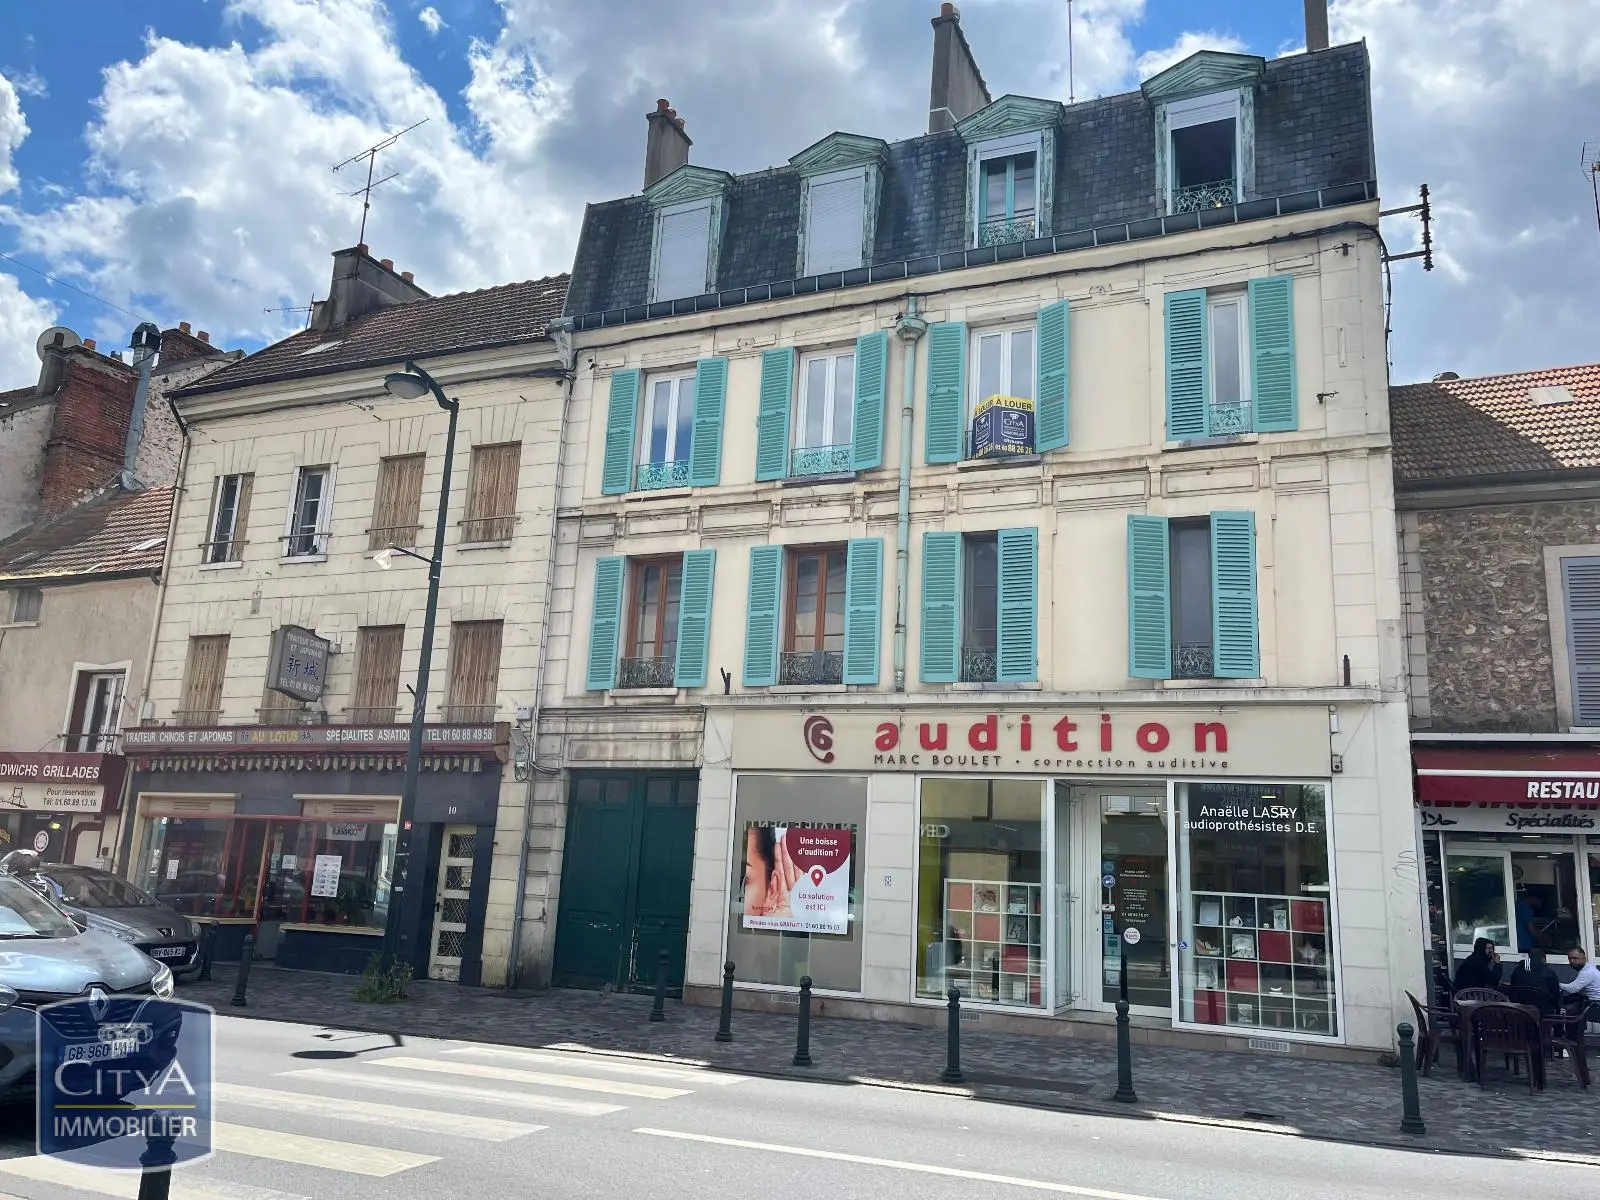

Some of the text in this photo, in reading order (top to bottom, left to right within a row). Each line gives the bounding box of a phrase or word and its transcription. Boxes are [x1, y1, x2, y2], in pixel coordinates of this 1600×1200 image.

[1004, 400, 1032, 411] LOUER
[286, 654, 320, 681] 新城
[126, 730, 233, 743] TRAITEUR CHINOIS ET JAPONAIS
[326, 729, 374, 741] SPECIALITES
[428, 729, 441, 741] TEL
[442, 729, 451, 741] 01
[451, 729, 461, 741] 60
[462, 729, 471, 741] 88
[472, 729, 482, 741] 49
[875, 713, 1228, 753] audition
[873, 755, 1229, 769] MARC BOULET correction auditive
[43, 765, 100, 779] GRILLADES
[46, 788, 60, 796] Pour
[1527, 781, 1600, 799] RESTAU
[448, 806, 457, 815] 10
[1200, 805, 1298, 819] Anaëlle LASRY
[1183, 818, 1320, 834] audioprothésistes D.E.
[1505, 813, 1595, 830] Spécialités
[800, 837, 838, 847] Une baisse
[798, 848, 833, 857] d'audition
[808, 892, 835, 901] solution
